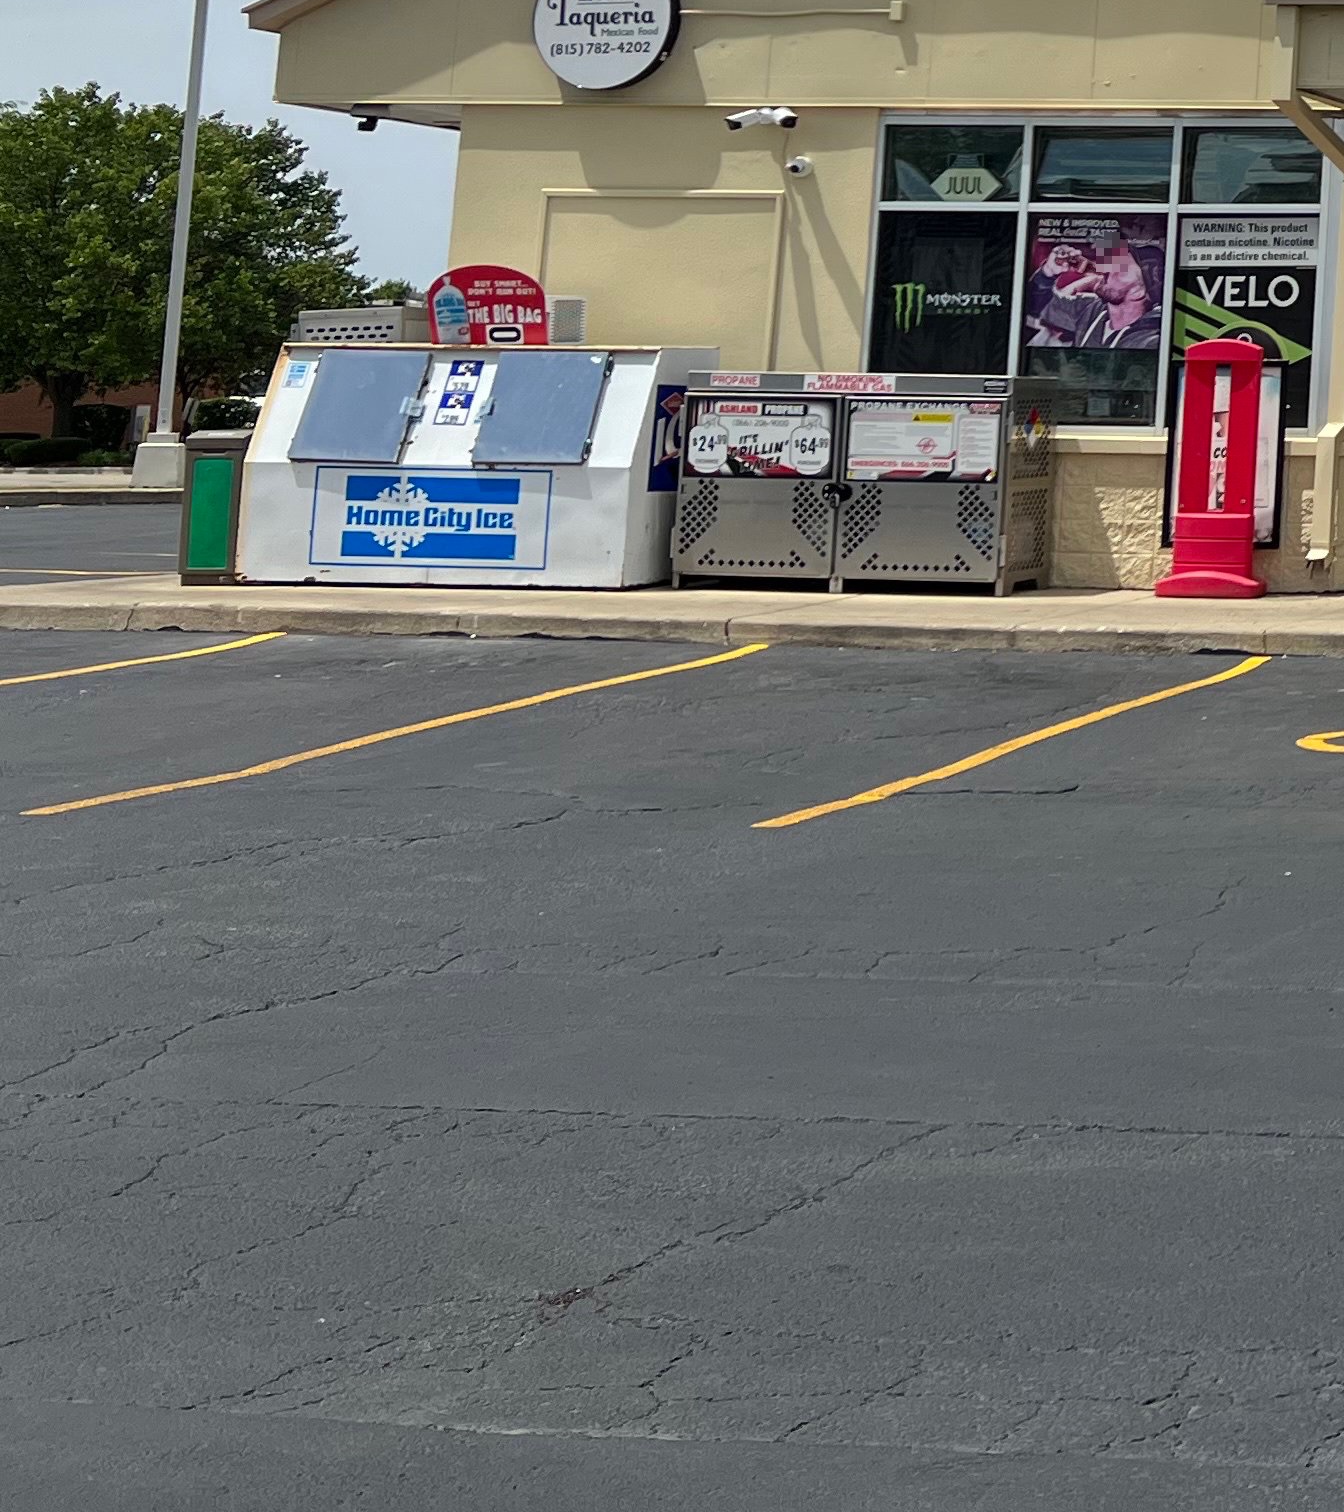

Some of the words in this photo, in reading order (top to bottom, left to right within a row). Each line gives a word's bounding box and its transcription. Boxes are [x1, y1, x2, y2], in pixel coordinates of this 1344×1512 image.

[600, 28, 635, 36] Mexican
[638, 26, 659, 36] Food
[586, 41, 651, 54] 782-4202
[945, 176, 982, 194] JUUL
[1039, 219, 1061, 227] NEW
[1038, 228, 1062, 236] REAL
[1192, 223, 1245, 233] WARNING:
[1248, 223, 1268, 233] This
[1271, 223, 1308, 235] product
[1184, 237, 1226, 247] contains
[1228, 237, 1270, 247] nicotine.
[1273, 237, 1315, 247] Nicotine
[1188, 251, 1197, 261] is
[1200, 252, 1212, 261] an
[1214, 251, 1260, 261] addictive
[1261, 251, 1309, 261] chemical.
[474, 280, 491, 288] BUY
[1196, 275, 1300, 308] VELO
[925, 291, 1002, 307] MONSTER
[467, 305, 491, 324] THE
[493, 303, 515, 324] BIG
[517, 305, 542, 324] BAG
[711, 375, 758, 386] PROPANE
[816, 374, 834, 384] NO
[835, 374, 884, 385] SMOKING
[872, 384, 893, 393] GAS
[719, 404, 758, 414] ASHLAND
[346, 505, 420, 527] Home
[424, 507, 472, 532] City
[476, 508, 514, 529] Ice
